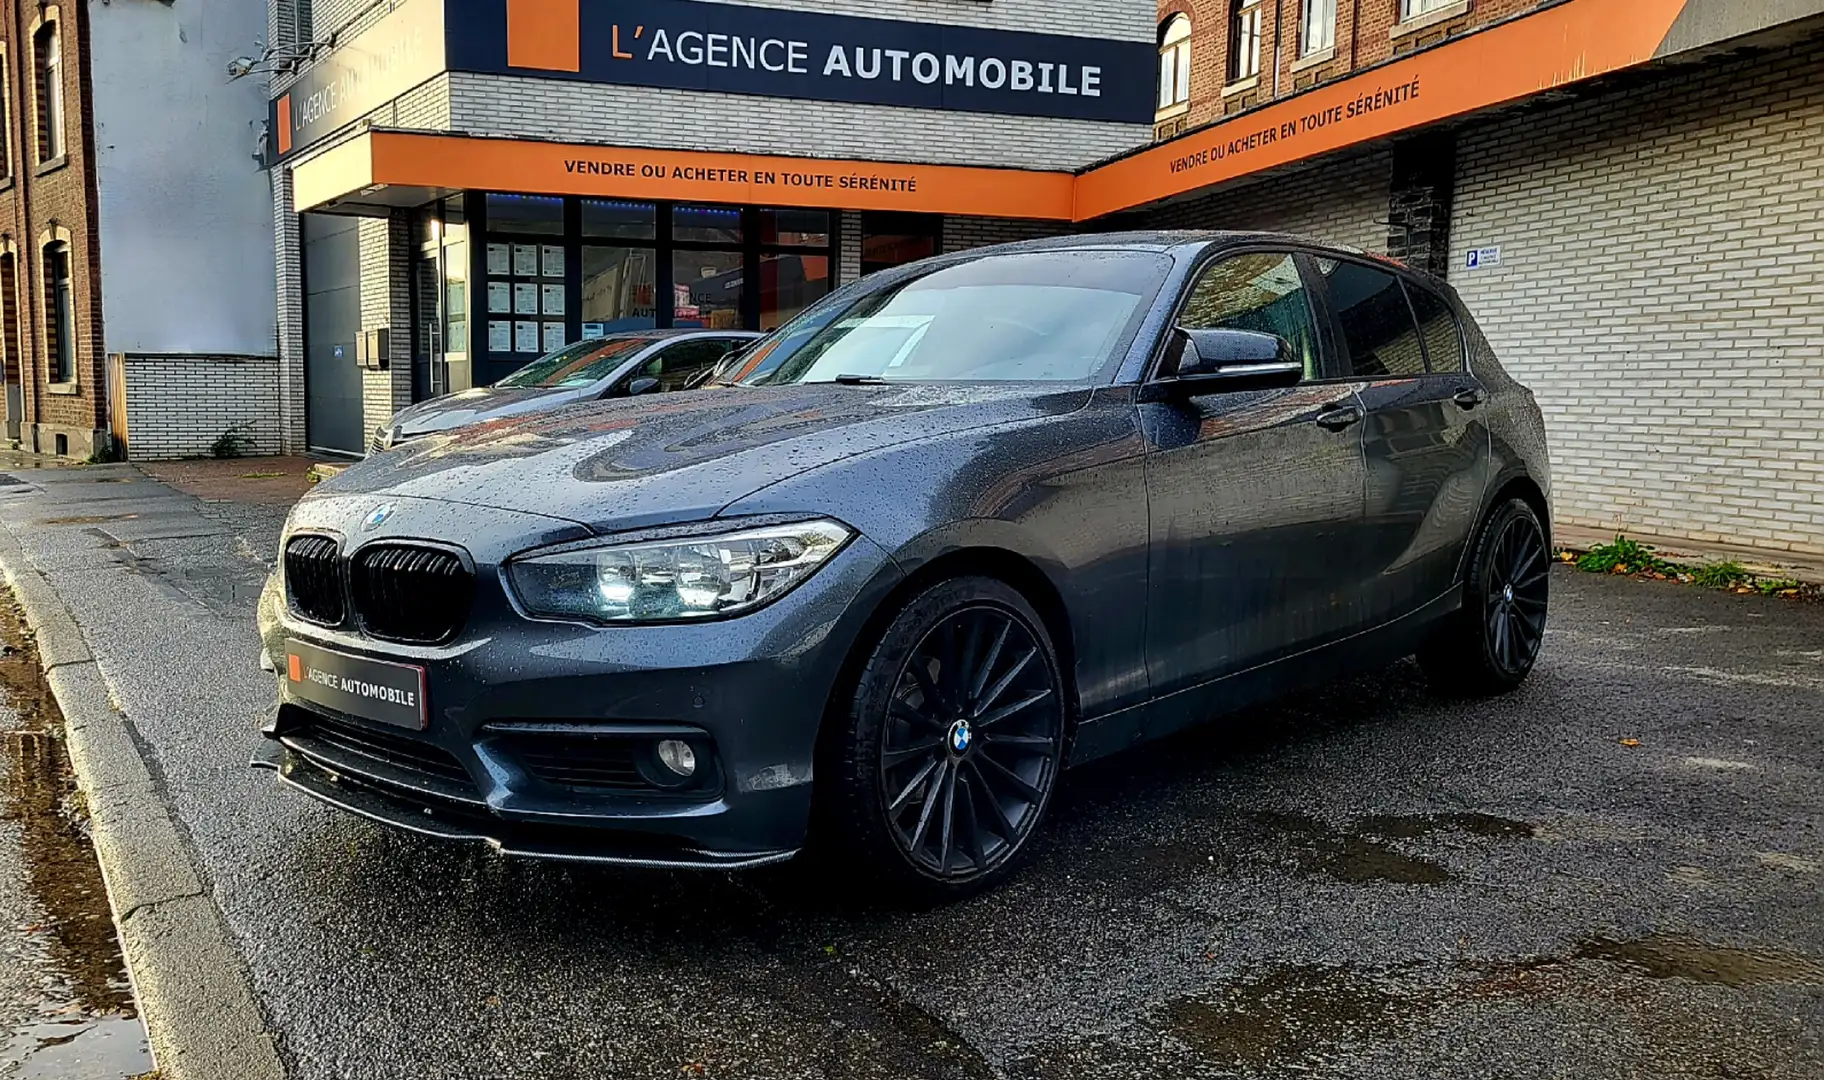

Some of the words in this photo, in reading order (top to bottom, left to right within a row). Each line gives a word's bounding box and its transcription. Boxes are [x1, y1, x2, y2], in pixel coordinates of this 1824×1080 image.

[612, 24, 808, 73] L'AGENCE
[823, 45, 1101, 97] AUTOMOBILE
[1170, 150, 1208, 174] VENDRE
[1210, 145, 1225, 161] OU
[1227, 127, 1277, 156] ACHETER
[1280, 120, 1297, 140] EN
[1300, 105, 1342, 132] TOUTE
[1346, 75, 1419, 119] SÉRÉNITÉ
[564, 160, 635, 177] VENDRE
[641, 165, 666, 178] OU
[672, 167, 748, 182] ACHETER
[754, 171, 775, 184] EN
[781, 173, 834, 187] TOUTE
[839, 173, 917, 192] SÉRÉNITÉ
[341, 678, 415, 706] AUTOMOBILE
